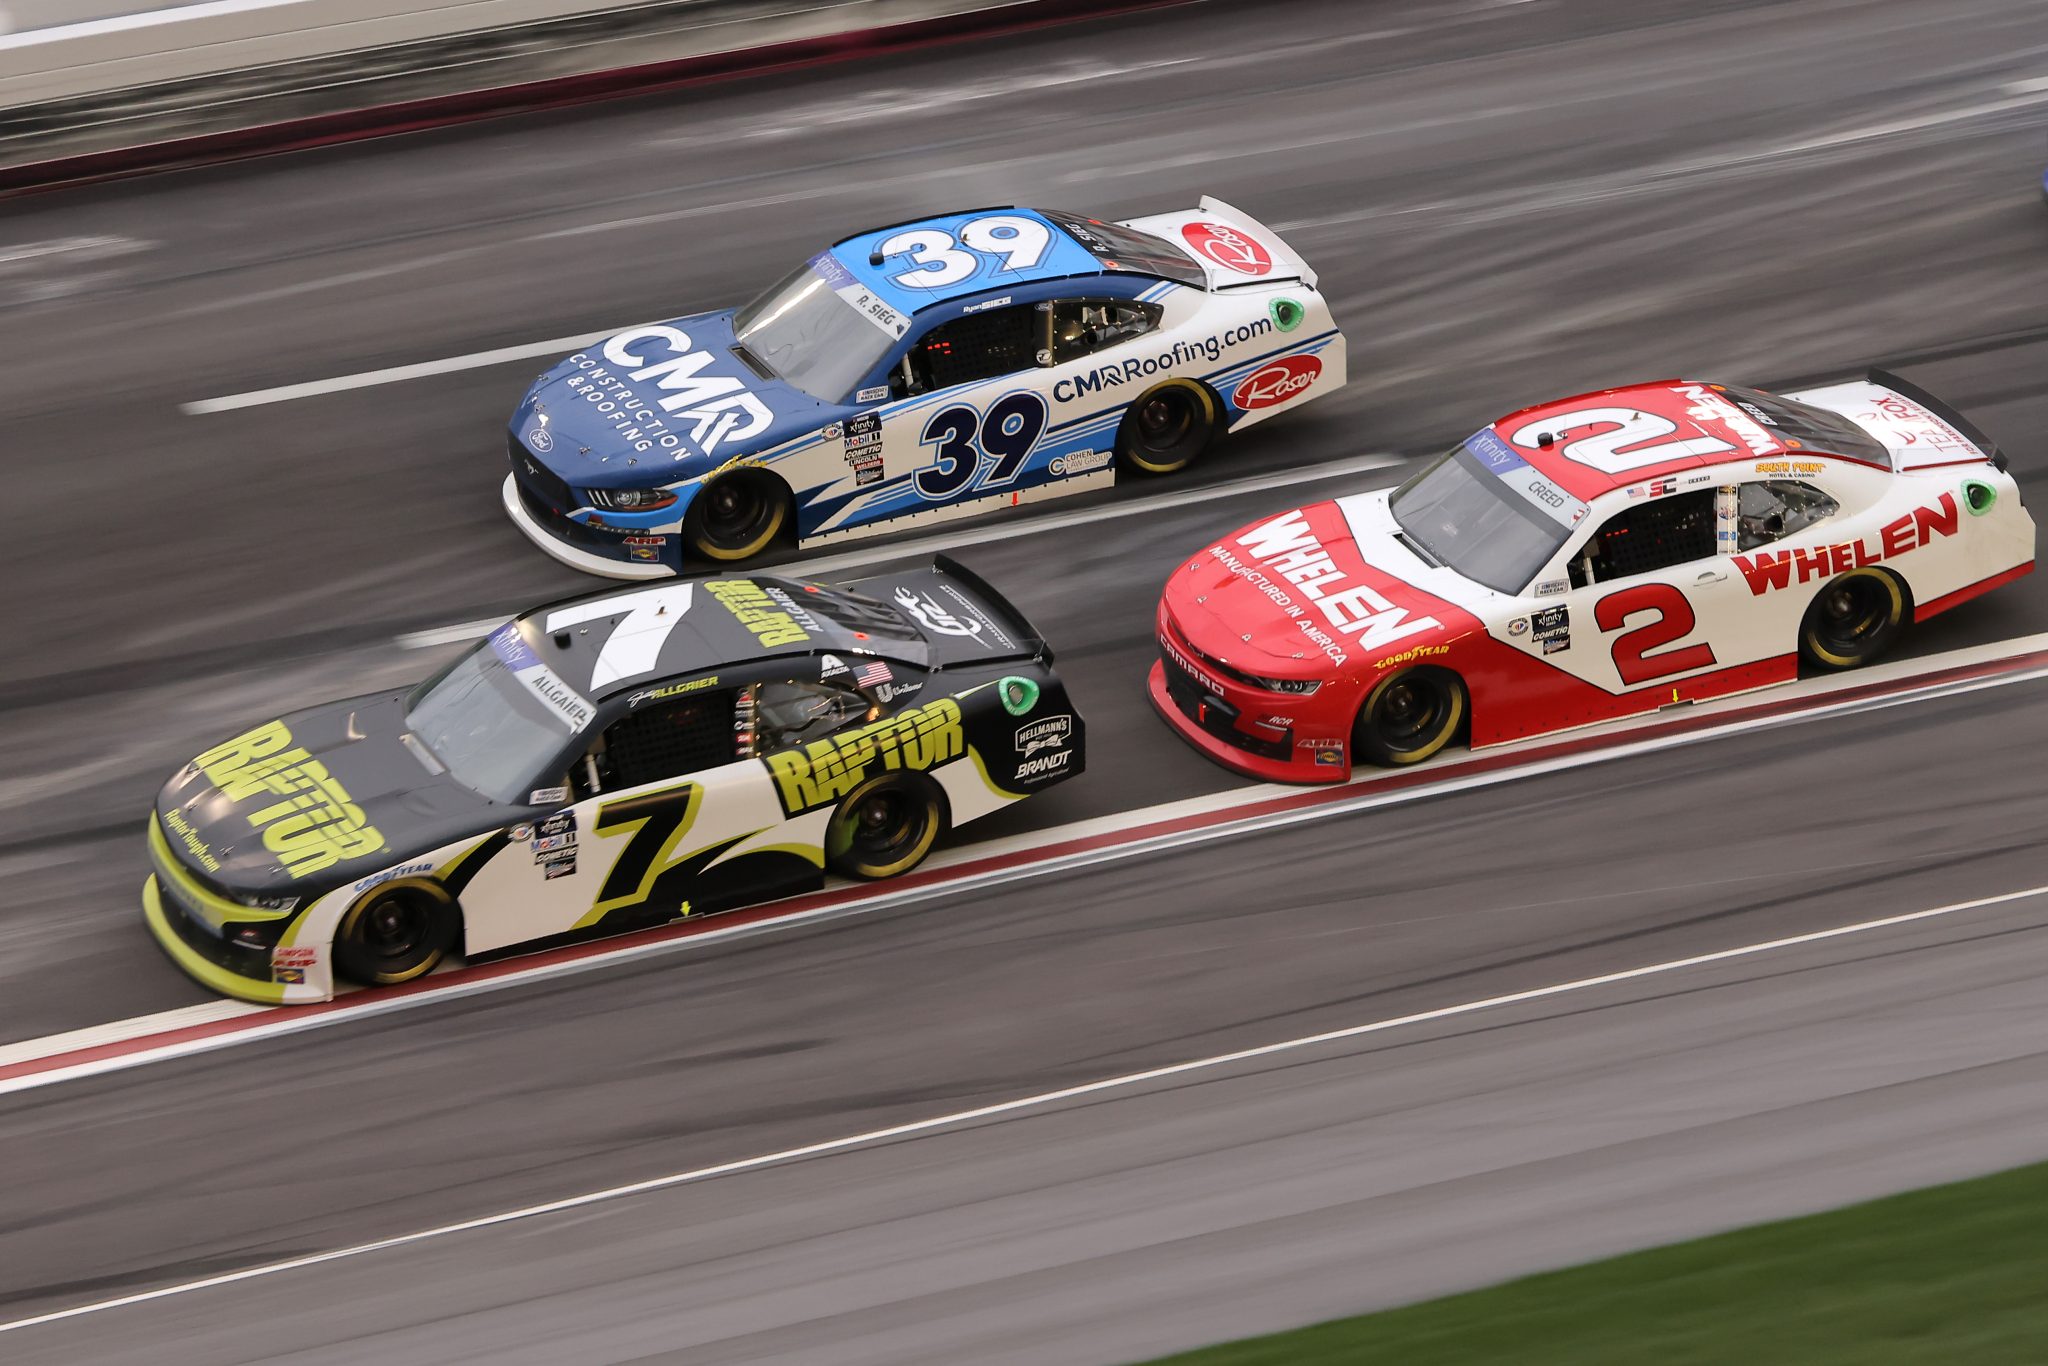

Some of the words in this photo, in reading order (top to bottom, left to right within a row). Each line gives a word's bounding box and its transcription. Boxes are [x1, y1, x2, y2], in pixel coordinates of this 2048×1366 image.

[1064, 223, 1097, 241] SIEG
[877, 215, 1053, 289] 39
[813, 255, 844, 284] xfinity
[857, 295, 869, 308] R.
[868, 304, 896, 325] SIEG
[569, 353, 692, 461] CONSTRUCTION
[603, 325, 774, 457] CMR
[577, 380, 653, 452] ROOFING
[1870, 397, 1919, 420] FOX
[532, 431, 549, 449] Ford
[844, 434, 870, 447] Mobil
[849, 421, 875, 433] xfinity
[1510, 407, 1737, 474] 2
[846, 444, 881, 460] COMETIC
[914, 390, 1049, 499] 39
[1066, 450, 1092, 462] COHEN
[1474, 434, 1511, 467] xfinity
[850, 456, 877, 467] LINCOLN
[1755, 462, 1790, 473] SOUTH
[1792, 462, 1825, 473] POINT
[1528, 481, 1565, 508] CREED
[624, 537, 666, 546] ARP
[1730, 491, 1959, 596] WHELEN
[1236, 509, 1441, 652] WHELEN
[704, 580, 811, 648] RAPTOR
[765, 587, 824, 632] ALLGAIER
[1209, 546, 1292, 608] MANUFACTURED
[1285, 604, 1304, 619] IN
[1296, 619, 1348, 668] AMERICA
[1538, 612, 1563, 626] xfinity
[546, 583, 693, 692] 7
[1533, 626, 1568, 641] COMETIC
[1594, 583, 1717, 686] 2
[1160, 633, 1225, 697] CAMARO
[1373, 645, 1450, 669] GOODYEAR
[531, 676, 588, 720] ALLGAIER
[651, 676, 719, 699] ALLGAIER
[1019, 719, 1067, 743] HELLMANN'S
[765, 698, 964, 812] RAPTOR
[1014, 750, 1073, 779] BRANDT
[193, 719, 385, 879] RAPTOR
[164, 807, 222, 874] RaptorTough.com
[593, 781, 704, 906] 7
